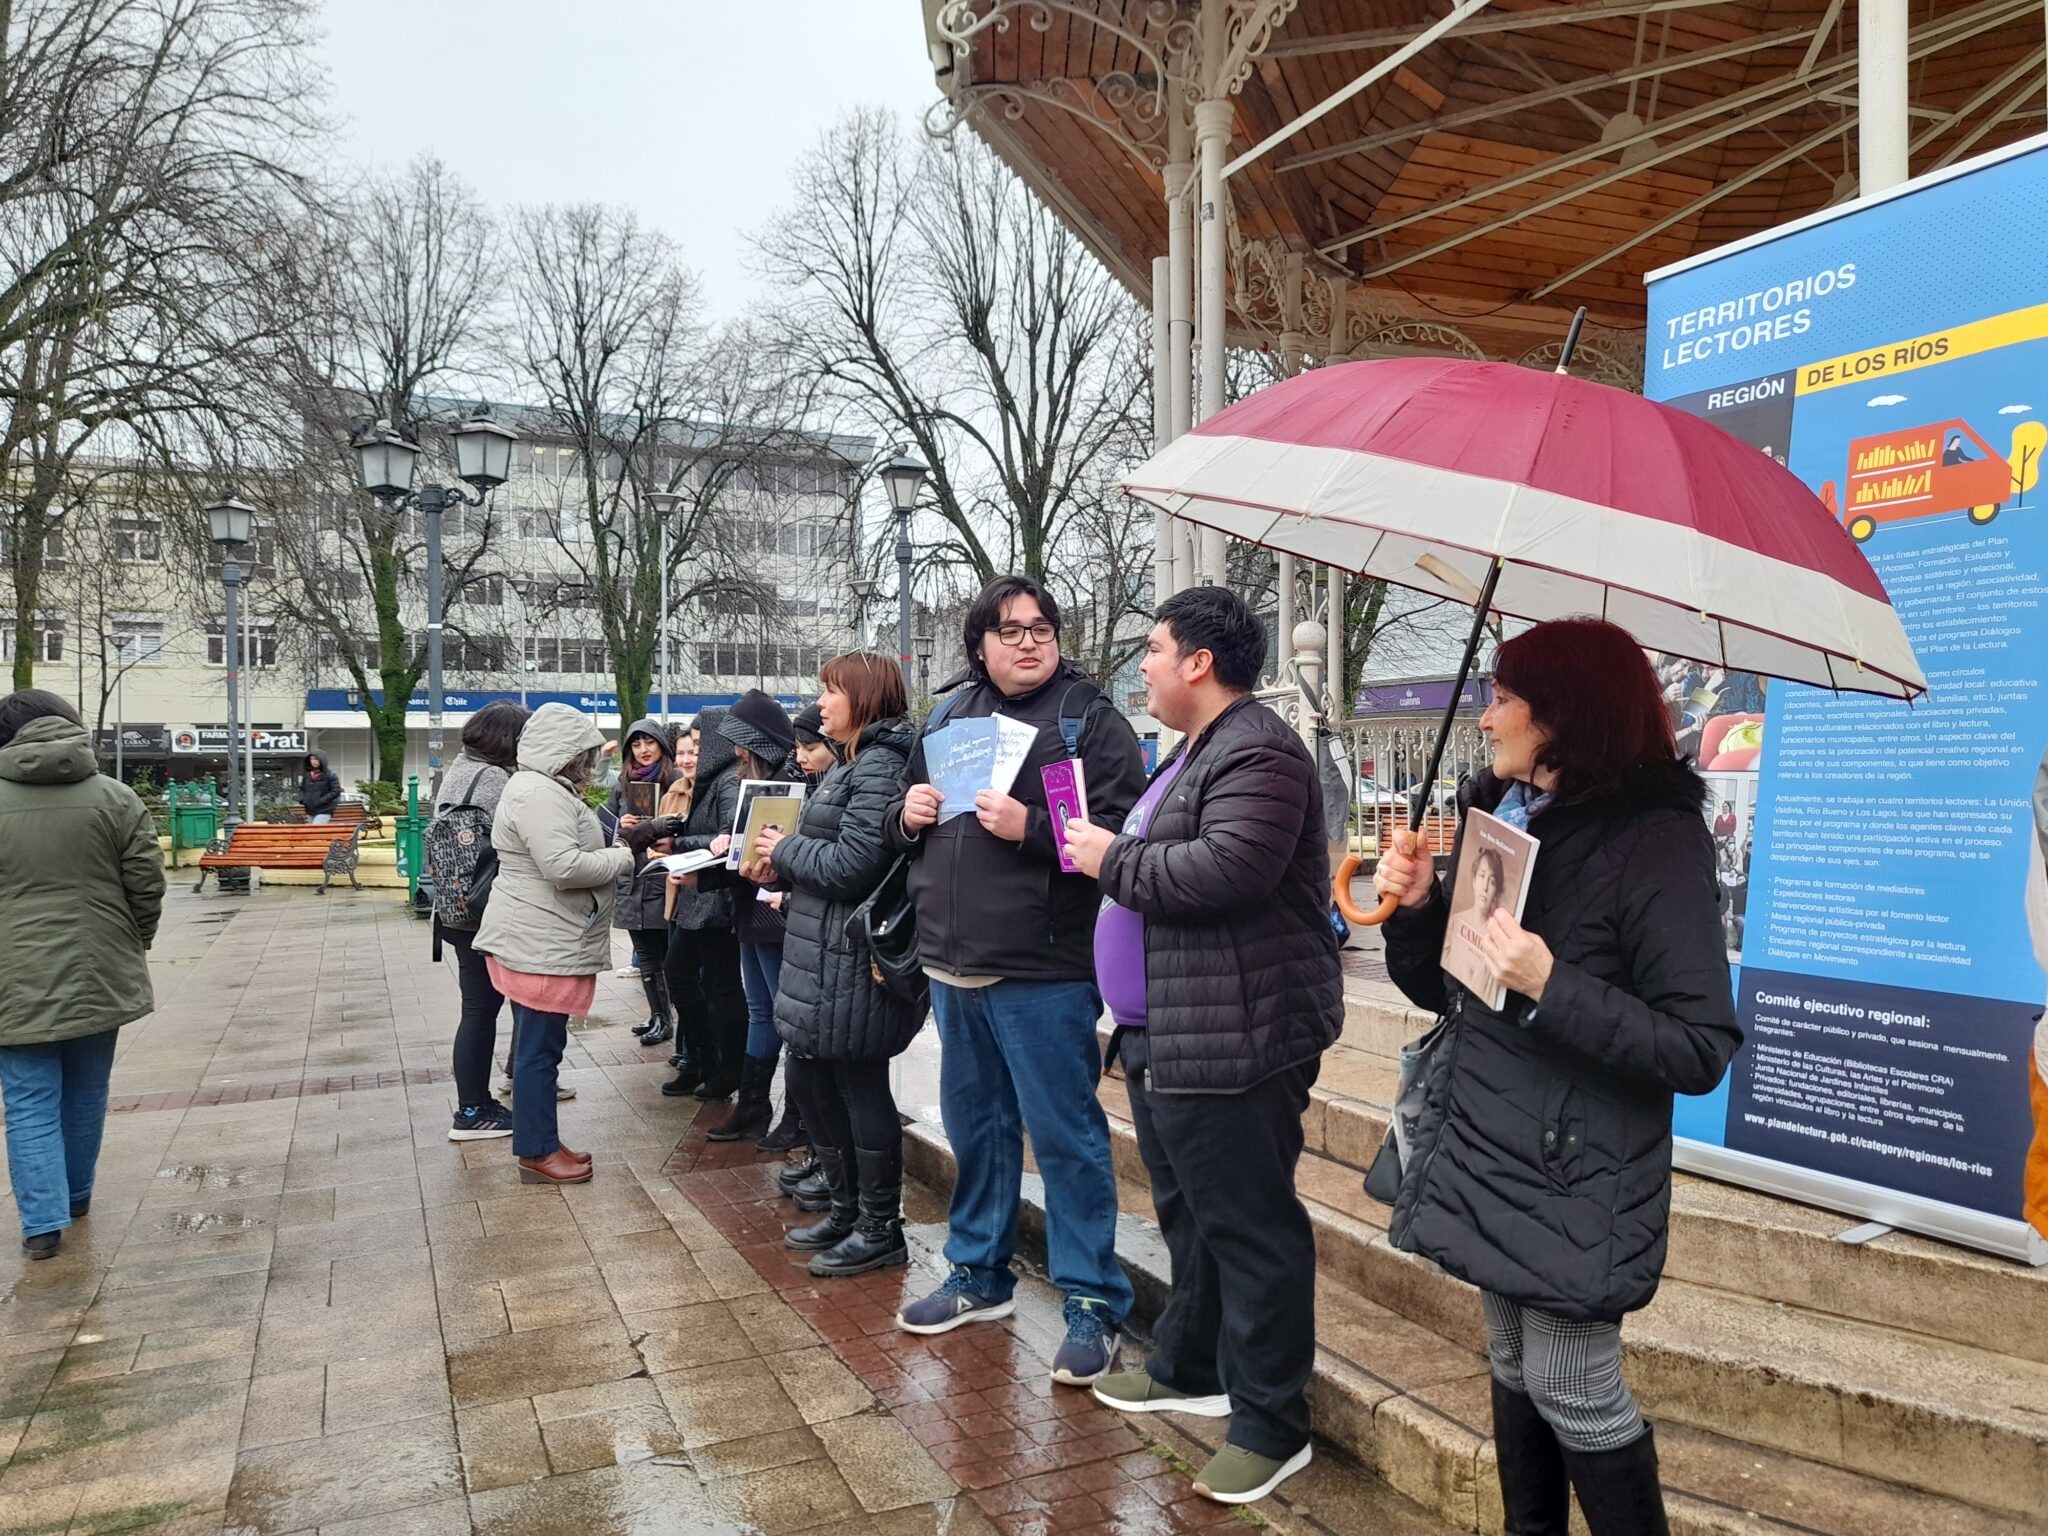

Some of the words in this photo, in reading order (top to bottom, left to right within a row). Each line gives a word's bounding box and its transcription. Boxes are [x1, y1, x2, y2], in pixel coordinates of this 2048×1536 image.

[1666, 263, 1857, 340] TERRITORIOS
[1662, 309, 1812, 370] LECTORES
[1707, 378, 1785, 410] REGIÓN
[1807, 365, 1834, 387] DE
[1841, 354, 1885, 379] LOS
[1893, 337, 1949, 366] RÍOS
[1882, 553, 1894, 561] las
[1972, 540, 1986, 550] del
[1988, 538, 2008, 547] Plan
[1916, 645, 1928, 654] del
[1930, 644, 1948, 653] Plan
[1950, 643, 1960, 652] de
[1963, 643, 1970, 651] la
[445, 696, 468, 706] Chile
[609, 699, 618, 707] de
[1400, 697, 1420, 706] CORONA
[255, 732, 300, 749] Prat
[1778, 759, 1796, 767] cada
[1814, 759, 1825, 767] de
[1899, 758, 1906, 767] lo
[1908, 760, 1923, 768] que
[1925, 758, 1945, 767] tiene
[1973, 758, 2010, 768] objetivo
[1837, 795, 1864, 805] trabaja
[1878, 796, 1902, 805] cuatro
[1905, 796, 1943, 805] territorios
[1984, 798, 1996, 807] La
[1822, 807, 1847, 815] Bueno
[1849, 809, 1854, 817] y
[1856, 807, 1870, 816] Los
[1901, 809, 1913, 818] los
[1915, 811, 1930, 819] que
[1933, 810, 1948, 819] han
[1950, 811, 1997, 820] expresado
[1773, 888, 1823, 900] Expediciones
[1825, 892, 1856, 902] lectoras
[1774, 877, 1810, 887] Programa
[1813, 879, 1823, 888] de
[1865, 883, 1875, 892] de
[1877, 884, 1925, 895] mediadores
[1771, 911, 1791, 921] Mesa
[1793, 915, 1824, 924] regional
[1772, 900, 1826, 913] Intervenciones
[1865, 910, 1878, 918] por
[1881, 910, 1889, 918] el
[1890, 910, 1924, 921] fomento
[1926, 913, 1949, 923] lector
[1770, 923, 1806, 935] Programa
[1808, 927, 1818, 936] de
[1820, 930, 1858, 940] proyectos
[1911, 940, 1924, 948] por
[1927, 939, 1935, 948] la
[1937, 940, 1966, 952] lectura
[1769, 935, 1807, 947] Encuentro
[1808, 941, 1839, 951] regional
[1841, 945, 1906, 958] correspondiente
[1915, 953, 1971, 966] asociatividad
[1802, 952, 1812, 960] en
[1814, 952, 1859, 966] Movimiento
[1755, 991, 1800, 1009] Comité
[1803, 999, 1865, 1018] ejecutivo
[1868, 1009, 1931, 1028] regional:
[1781, 1018, 1790, 1026] de
[1852, 1030, 1856, 1038] y
[1890, 1038, 1905, 1046] que
[1908, 1040, 1939, 1051] sesiona
[1756, 1052, 1790, 1066] Ministerio
[1791, 1059, 1801, 1068] de
[1803, 1061, 1813, 1070] las
[1850, 1070, 1861, 1079] las
[1863, 1072, 1883, 1083] Artes
[1885, 1078, 1890, 1086] y
[1892, 1078, 1899, 1087] el
[1901, 1080, 1944, 1095] Patrimonio
[1757, 1043, 1791, 1056] Ministerio
[1792, 1049, 1802, 1058] de
[1843, 1058, 1888, 1074] (Bibliotecas
[1890, 1068, 1929, 1082] Escolares
[1931, 1075, 1954, 1087] CRA)
[1755, 1063, 1775, 1074] Junta
[1776, 1067, 1807, 1080] Nacional
[1809, 1073, 1818, 1082] de
[1820, 1075, 1852, 1088] Jardines
[1854, 1081, 1888, 1095] Infantiles
[1775, 1097, 1813, 1112] vinculados
[1815, 1106, 1822, 1114] al
[1824, 1107, 1840, 1118] libro
[1842, 1112, 1847, 1120] y
[1848, 1112, 1856, 1121] la
[1857, 1114, 1883, 1127] lectura
[1859, 1105, 1880, 1115] entre
[1883, 1110, 1903, 1121] otros
[1906, 1115, 1938, 1128] agentes
[1943, 1121, 1954, 1131] de
[1956, 1124, 1964, 1133] la
